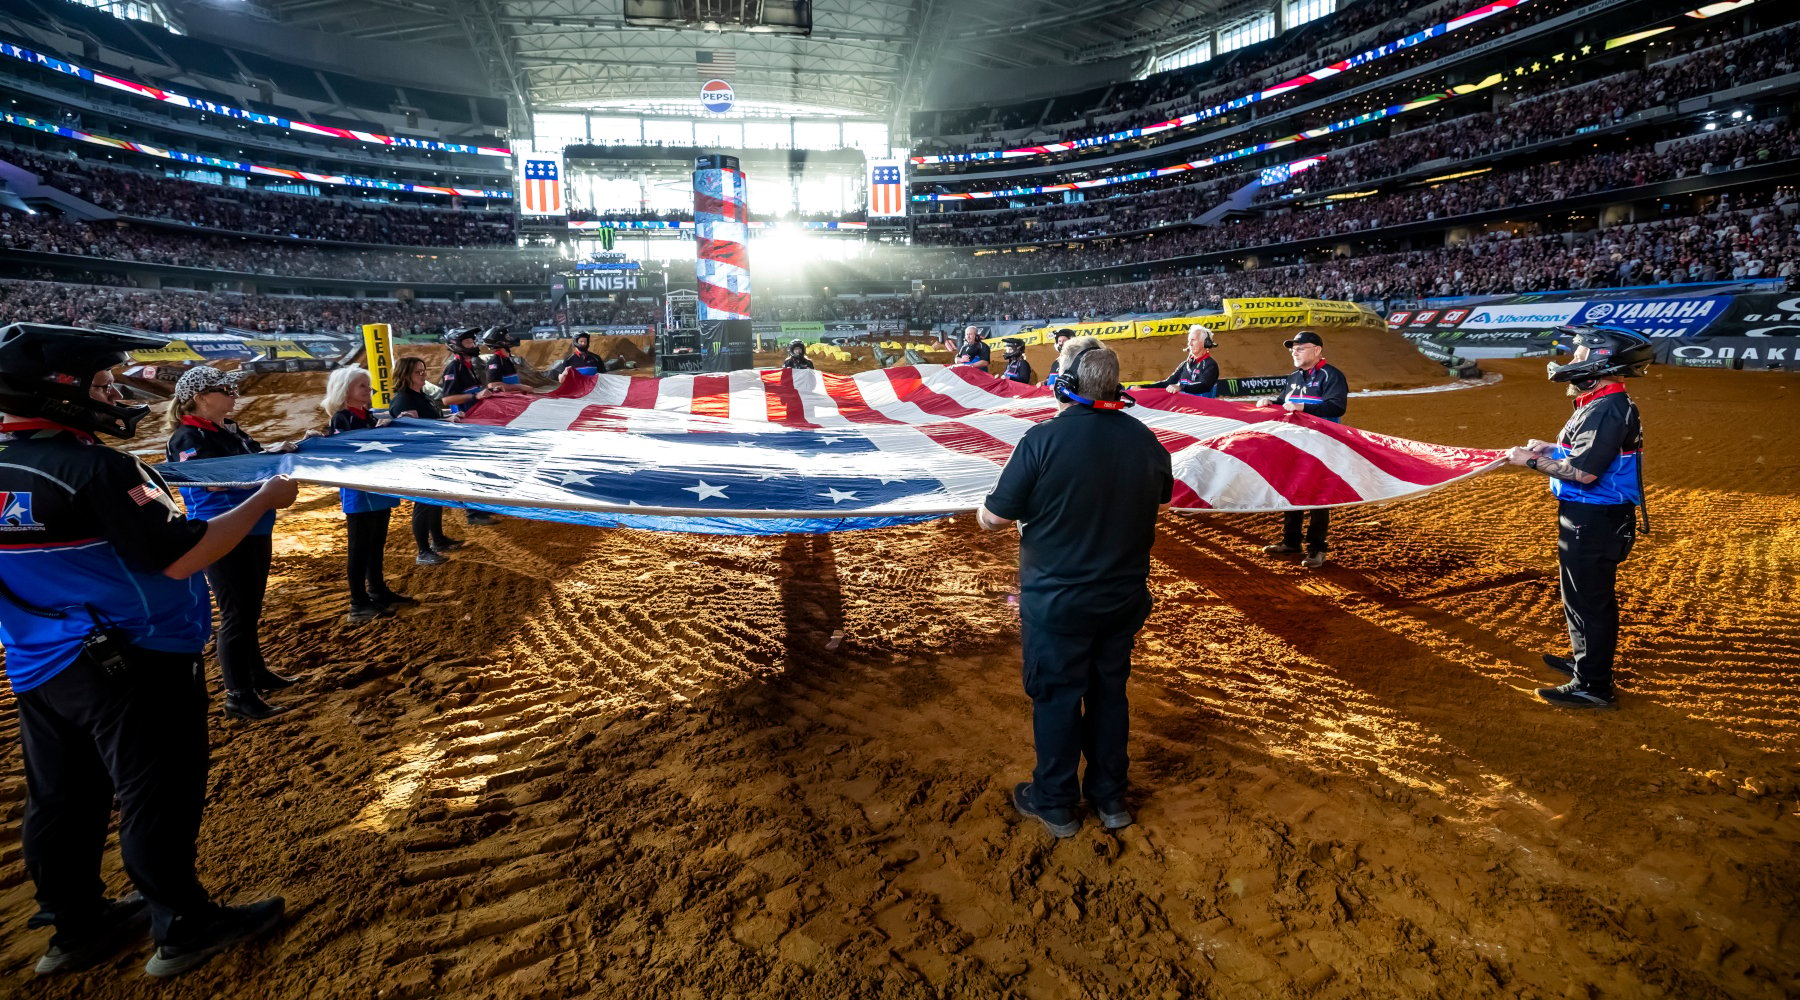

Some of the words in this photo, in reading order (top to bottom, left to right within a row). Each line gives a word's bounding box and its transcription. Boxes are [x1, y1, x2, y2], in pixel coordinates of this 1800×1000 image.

[702, 92, 733, 101] PEPSI
[579, 276, 637, 290] FINISH
[1612, 300, 1716, 318] YAMAHA
[1249, 316, 1305, 325] DUNLOP
[1390, 313, 1408, 323] QT
[1416, 311, 1436, 321] QT
[1445, 311, 1465, 322] QT
[1491, 314, 1570, 324] Albertsons
[1074, 325, 1130, 337] UNLOP
[1157, 321, 1226, 333] DUNOP
[192, 343, 248, 351] FALKEN
[989, 336, 1038, 349] DUOP
[374, 329, 390, 405] LEADER
[1241, 378, 1288, 389] MONSTER
